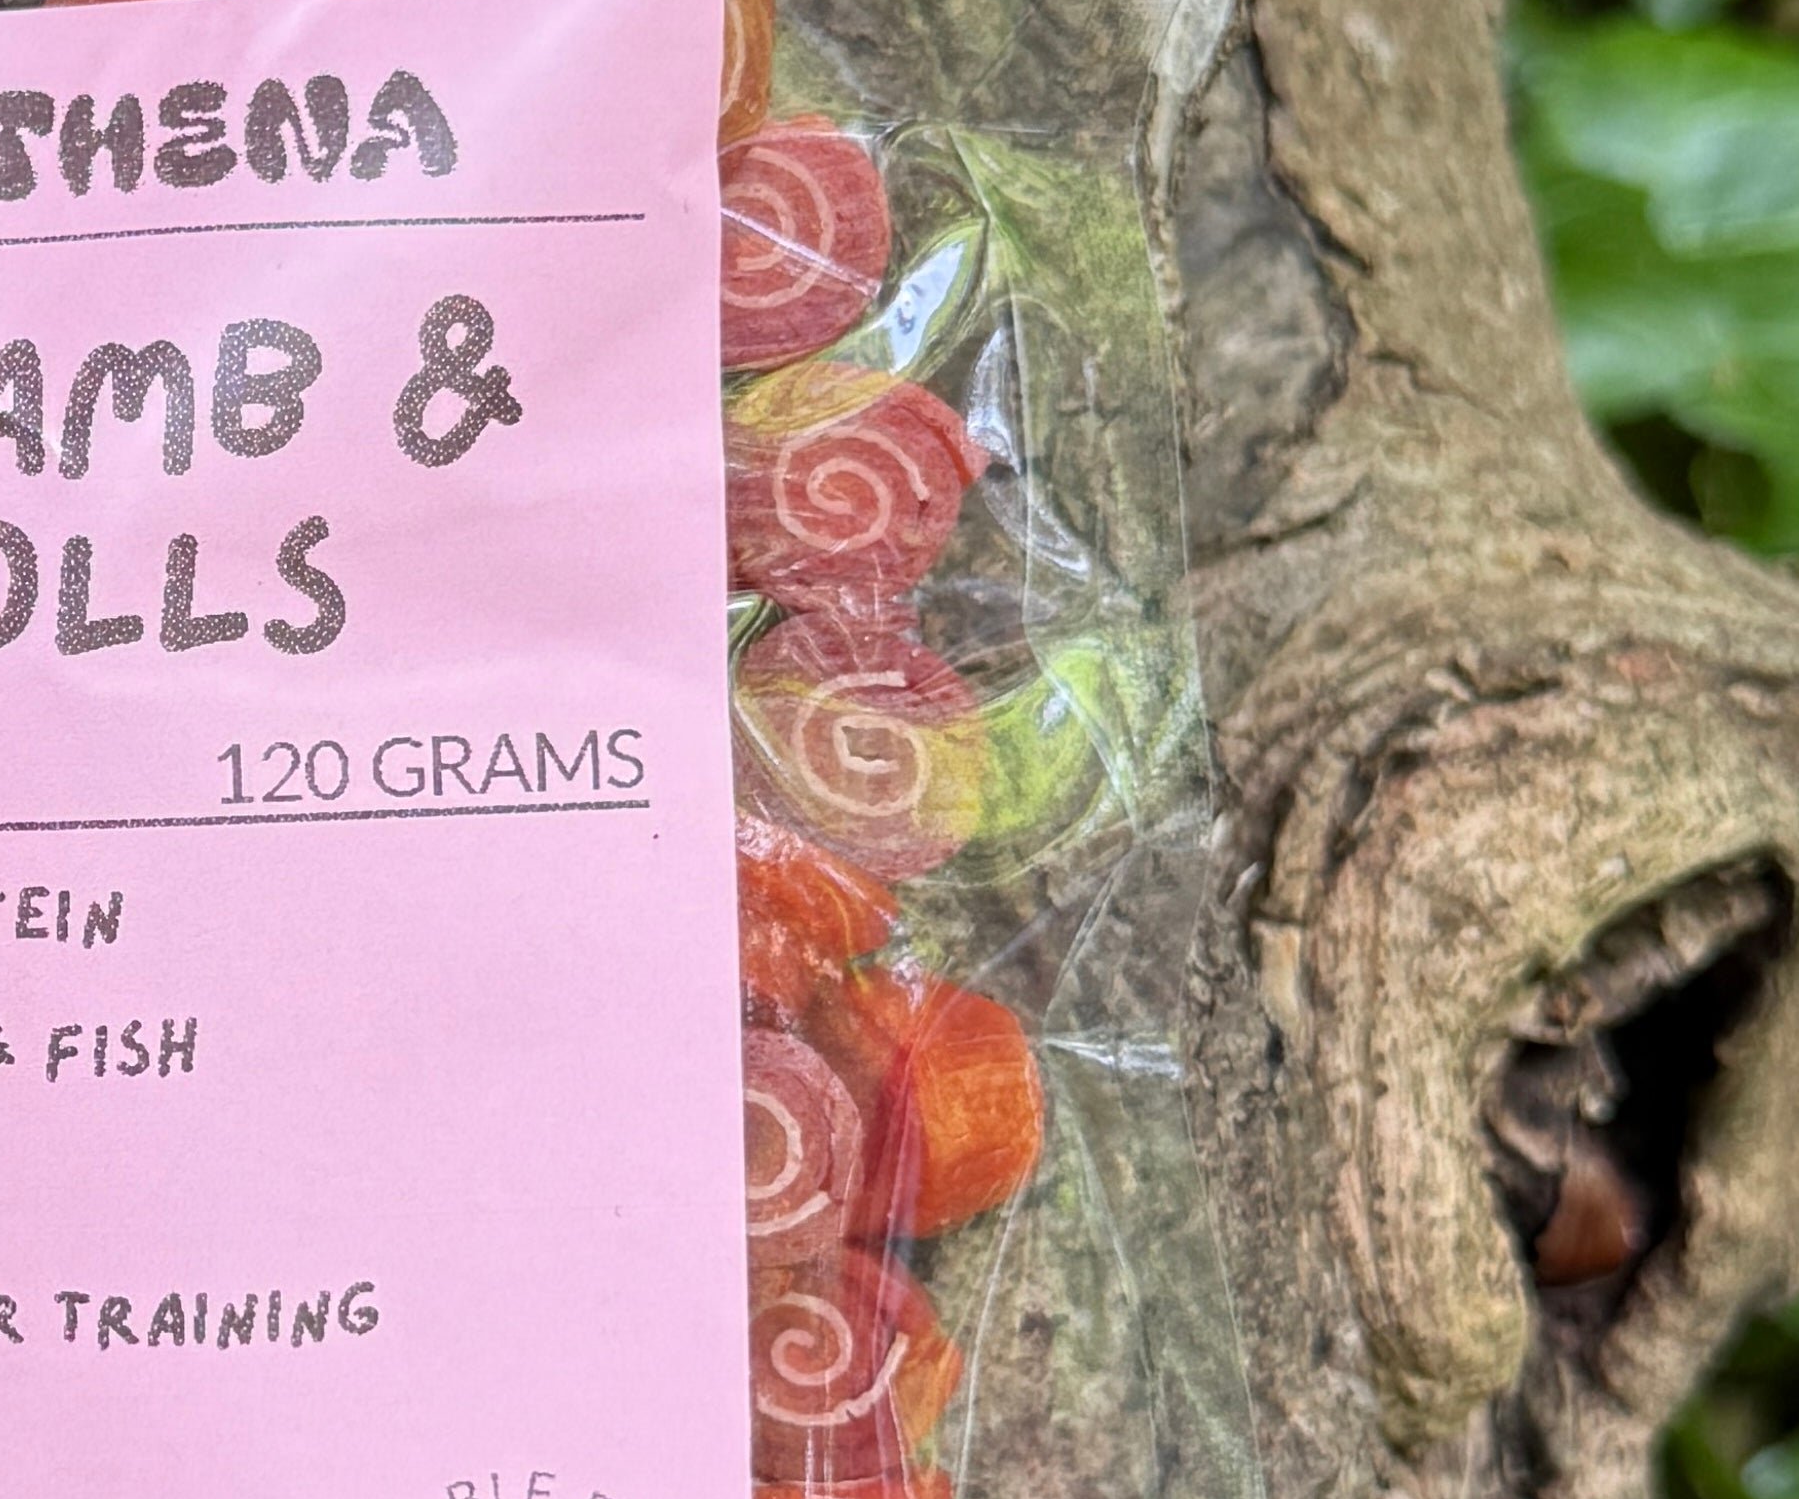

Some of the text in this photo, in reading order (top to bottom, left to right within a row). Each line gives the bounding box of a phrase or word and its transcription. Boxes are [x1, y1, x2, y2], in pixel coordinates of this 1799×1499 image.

[393, 294, 524, 468] &
[218, 729, 645, 804] 120 GRAMS
[46, 1017, 198, 1084] FISH
[54, 1282, 380, 1352] TRAINING
